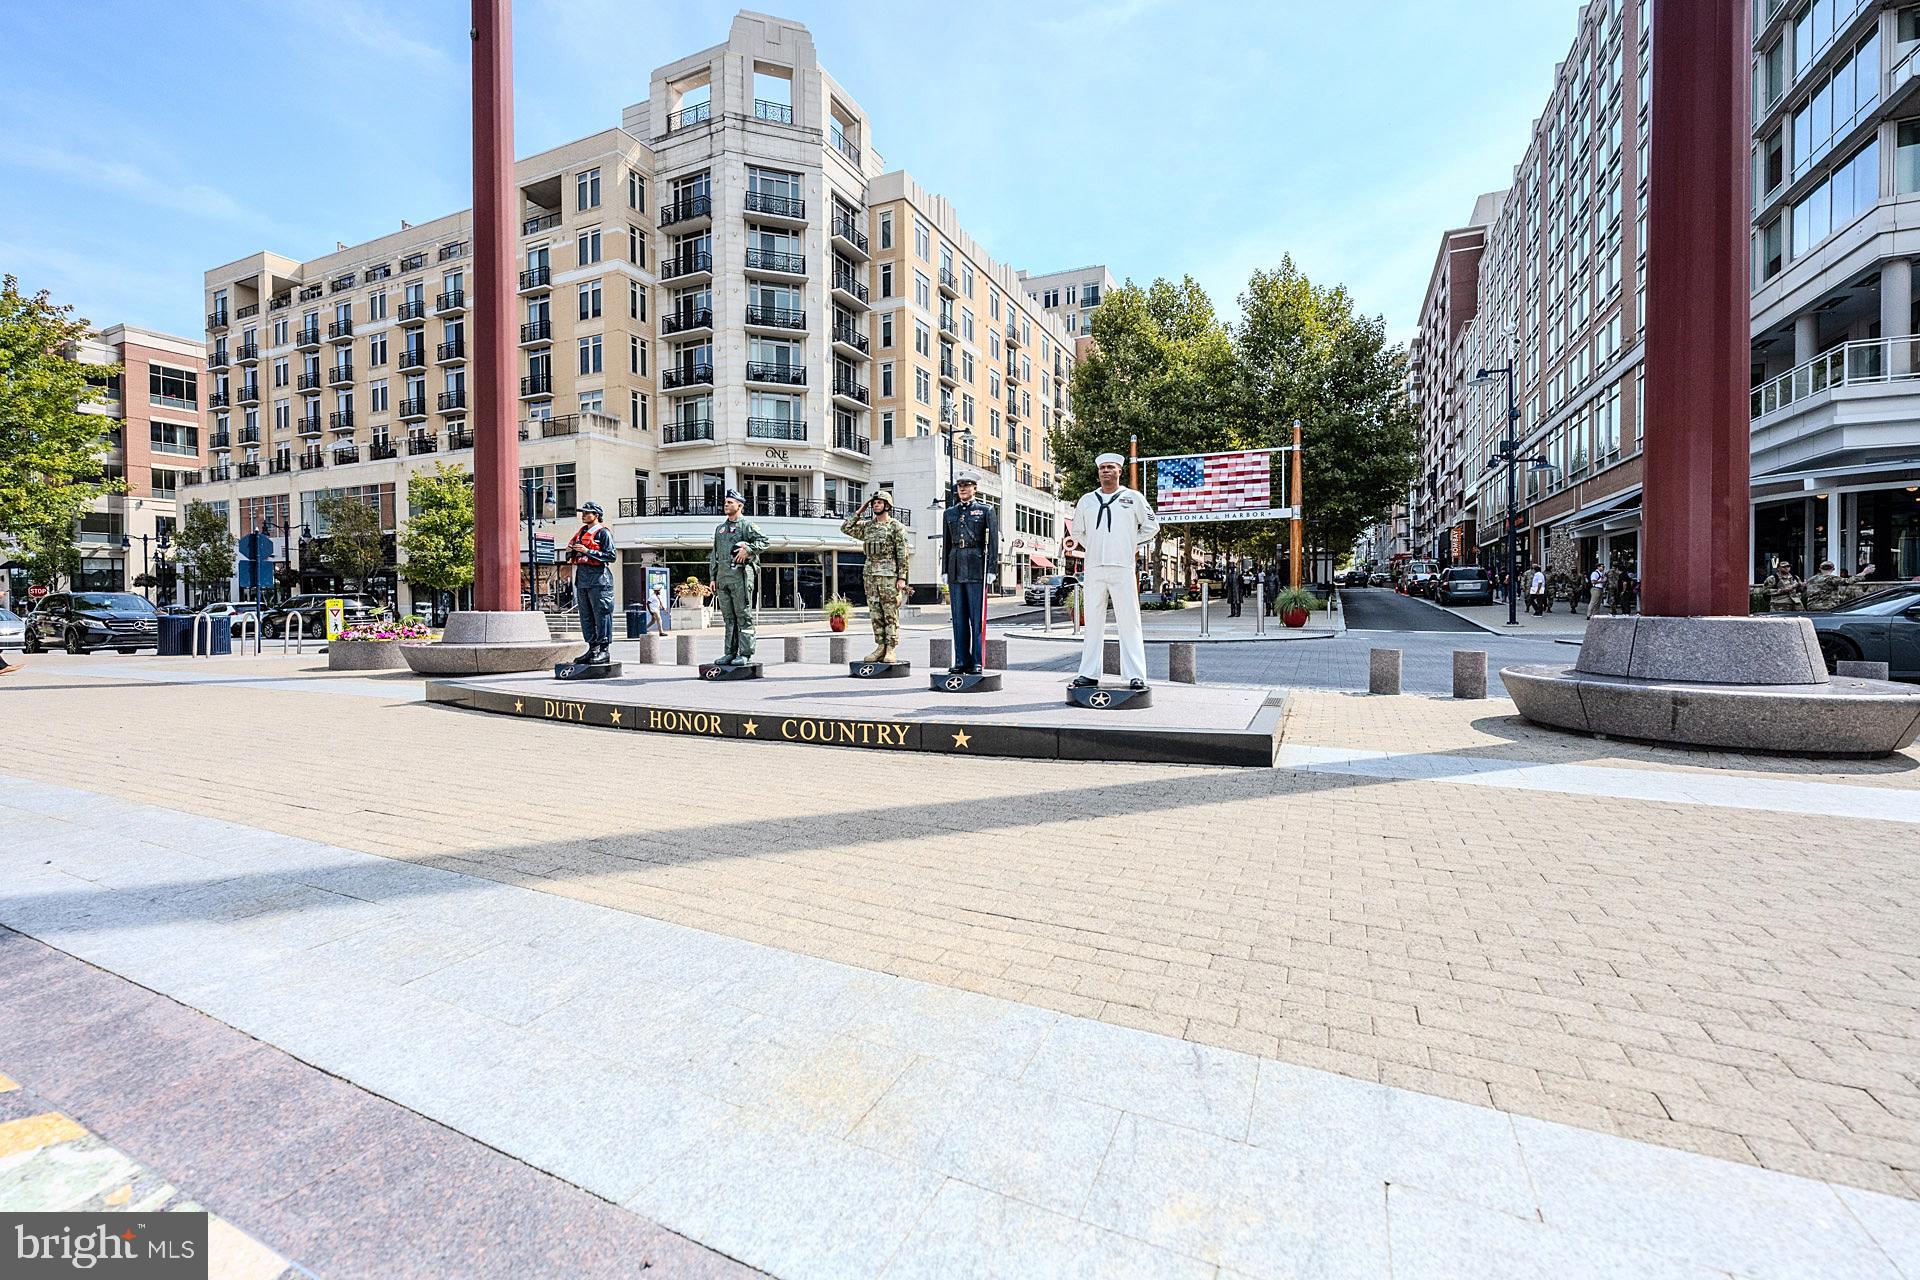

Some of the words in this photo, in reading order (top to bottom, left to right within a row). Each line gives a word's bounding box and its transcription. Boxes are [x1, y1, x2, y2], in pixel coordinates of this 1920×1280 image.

[765, 446, 789, 461] ONE
[1224, 511, 1265, 519] HARBOR
[544, 700, 586, 721] DUTY
[649, 710, 723, 735] HONOR
[781, 719, 910, 746] COUNTRY
